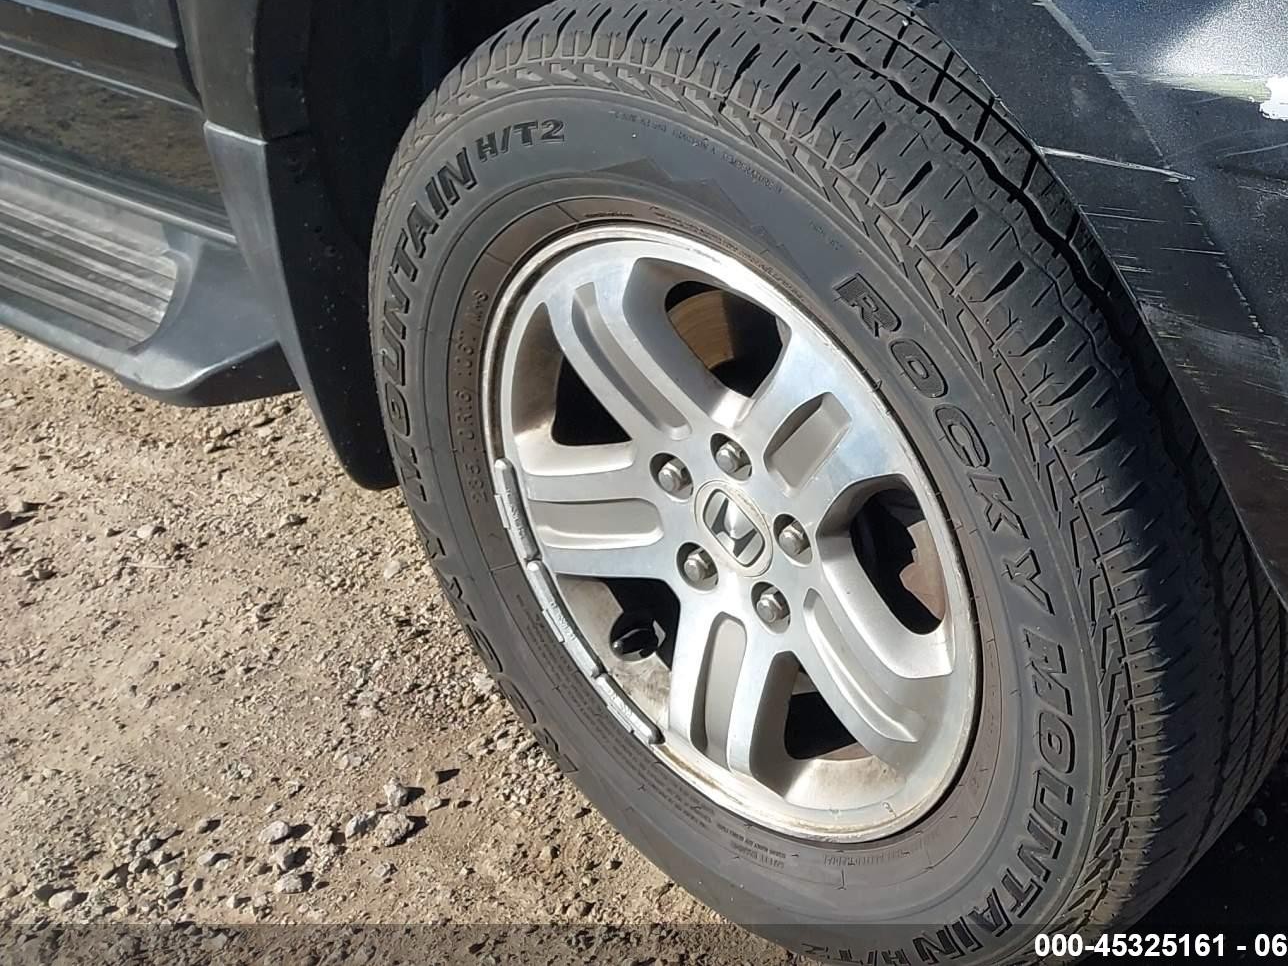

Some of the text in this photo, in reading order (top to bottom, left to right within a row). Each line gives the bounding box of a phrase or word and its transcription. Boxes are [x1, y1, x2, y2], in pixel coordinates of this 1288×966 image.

[380, 146, 478, 504] MOUNTAIN
[474, 118, 566, 163] H/T2
[833, 272, 1056, 617] ROCKY
[912, 626, 1077, 965] MOUNTAIN
